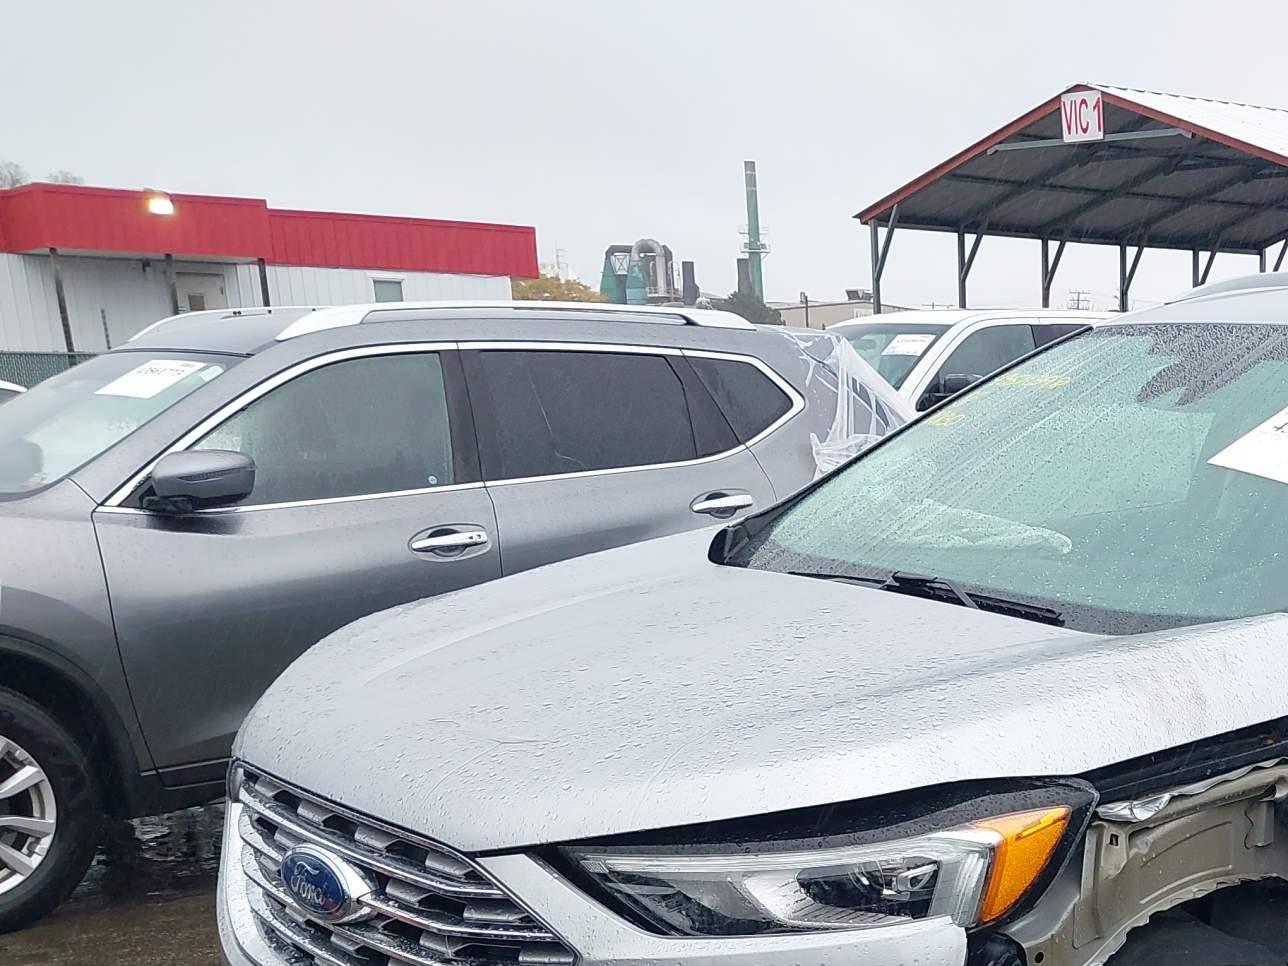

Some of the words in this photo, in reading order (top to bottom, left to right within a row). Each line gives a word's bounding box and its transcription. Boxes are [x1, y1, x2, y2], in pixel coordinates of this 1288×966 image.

[1062, 98, 1090, 135] VIC
[1092, 97, 1102, 132] 1
[290, 860, 330, 906] Ford
